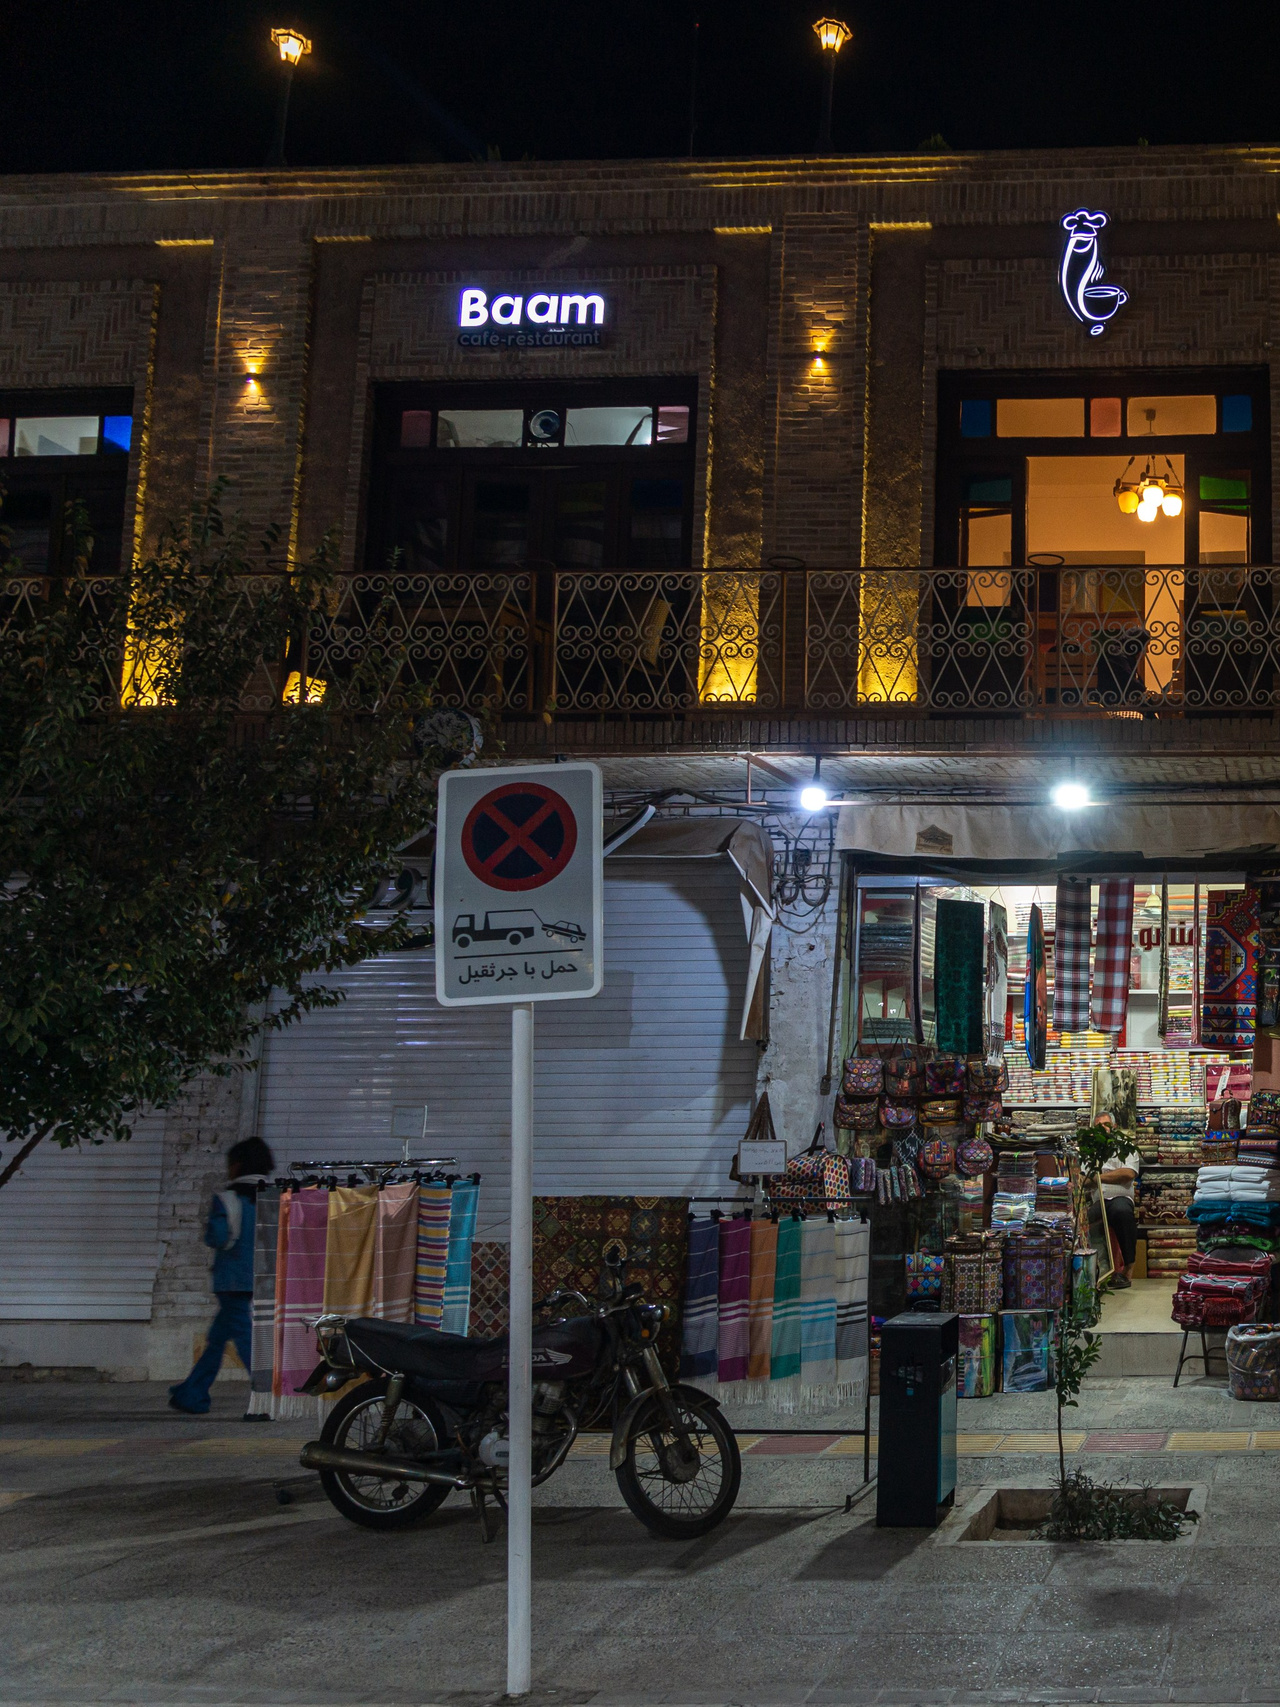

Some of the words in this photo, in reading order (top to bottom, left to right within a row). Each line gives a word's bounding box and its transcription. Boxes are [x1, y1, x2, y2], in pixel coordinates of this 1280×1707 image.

[460, 287, 606, 328] Baam
[458, 962, 518, 985] جرثقیل
[523, 961, 536, 980] با
[540, 959, 578, 980] حمل
